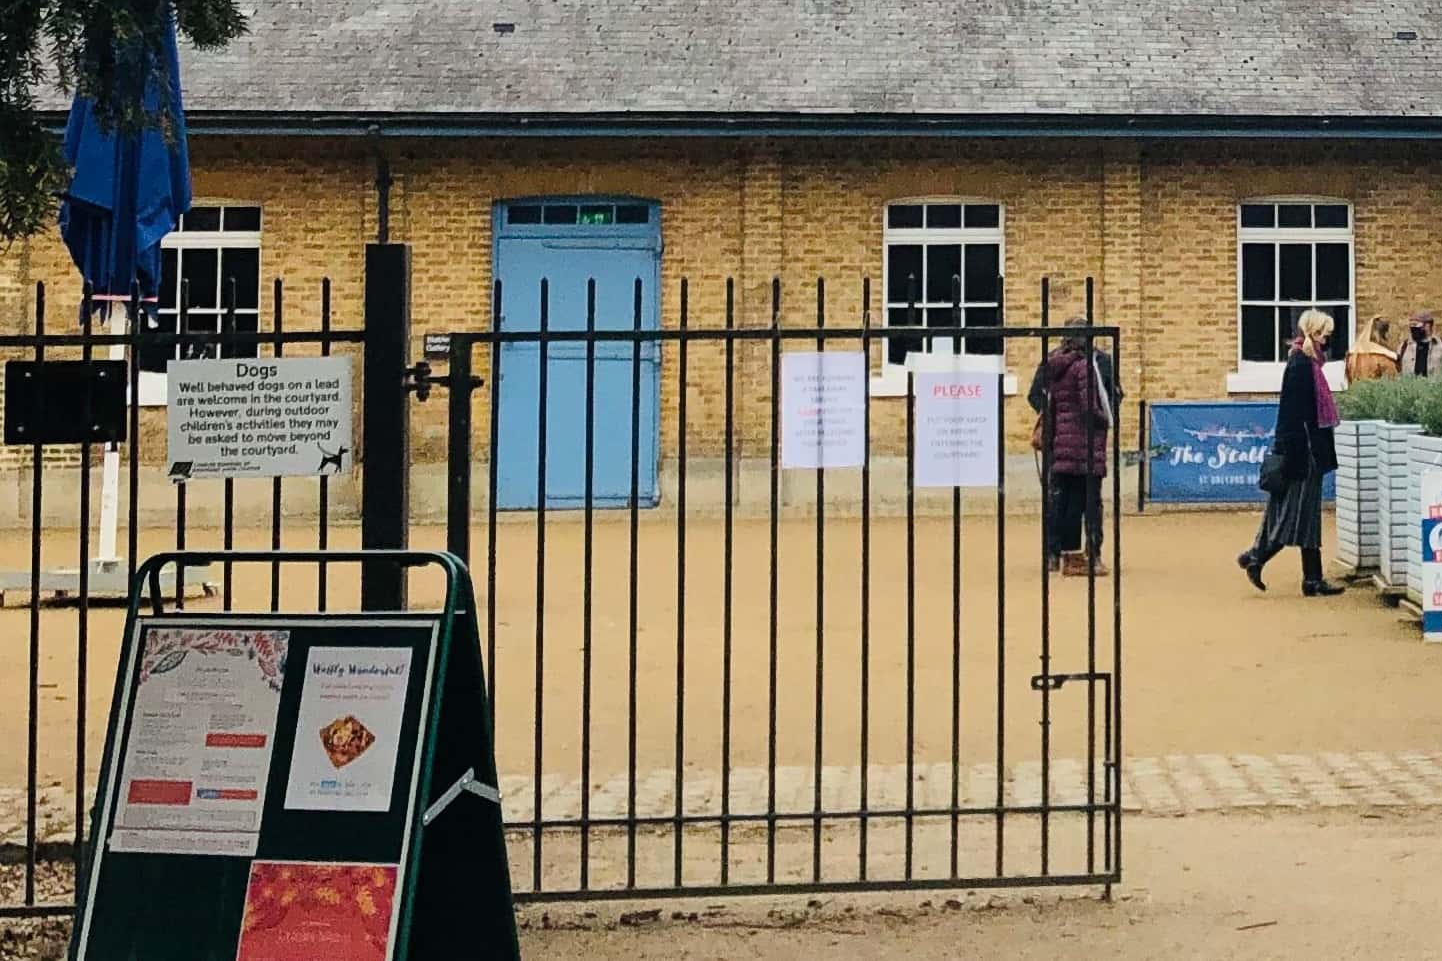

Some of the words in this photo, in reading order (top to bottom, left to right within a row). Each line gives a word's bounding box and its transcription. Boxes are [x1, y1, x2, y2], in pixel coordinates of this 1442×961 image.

[236, 363, 278, 379] Dogs
[179, 382, 204, 393] Well
[207, 383, 254, 392] behaved
[258, 381, 285, 392] dogs
[315, 379, 339, 389] lead
[933, 384, 983, 397] PLEASE
[177, 398, 194, 406] are
[198, 394, 247, 405] welcome
[250, 393, 261, 403] in
[264, 393, 282, 403] the
[285, 391, 341, 404] courtyard.
[189, 408, 241, 418] However,
[246, 407, 281, 418] during
[285, 406, 329, 415] outdoor
[180, 421, 233, 432] children's
[236, 420, 285, 430] activities
[289, 418, 312, 430] they
[316, 418, 339, 429] may
[188, 434, 202, 444] be
[205, 433, 238, 443] asked
[242, 432, 253, 442] to
[257, 433, 286, 442] move
[290, 431, 330, 443] beyond
[221, 446, 239, 457] the
[242, 445, 297, 457] courtyard.
[1169, 445, 1204, 466] The
[1207, 443, 1272, 469] Stabl
